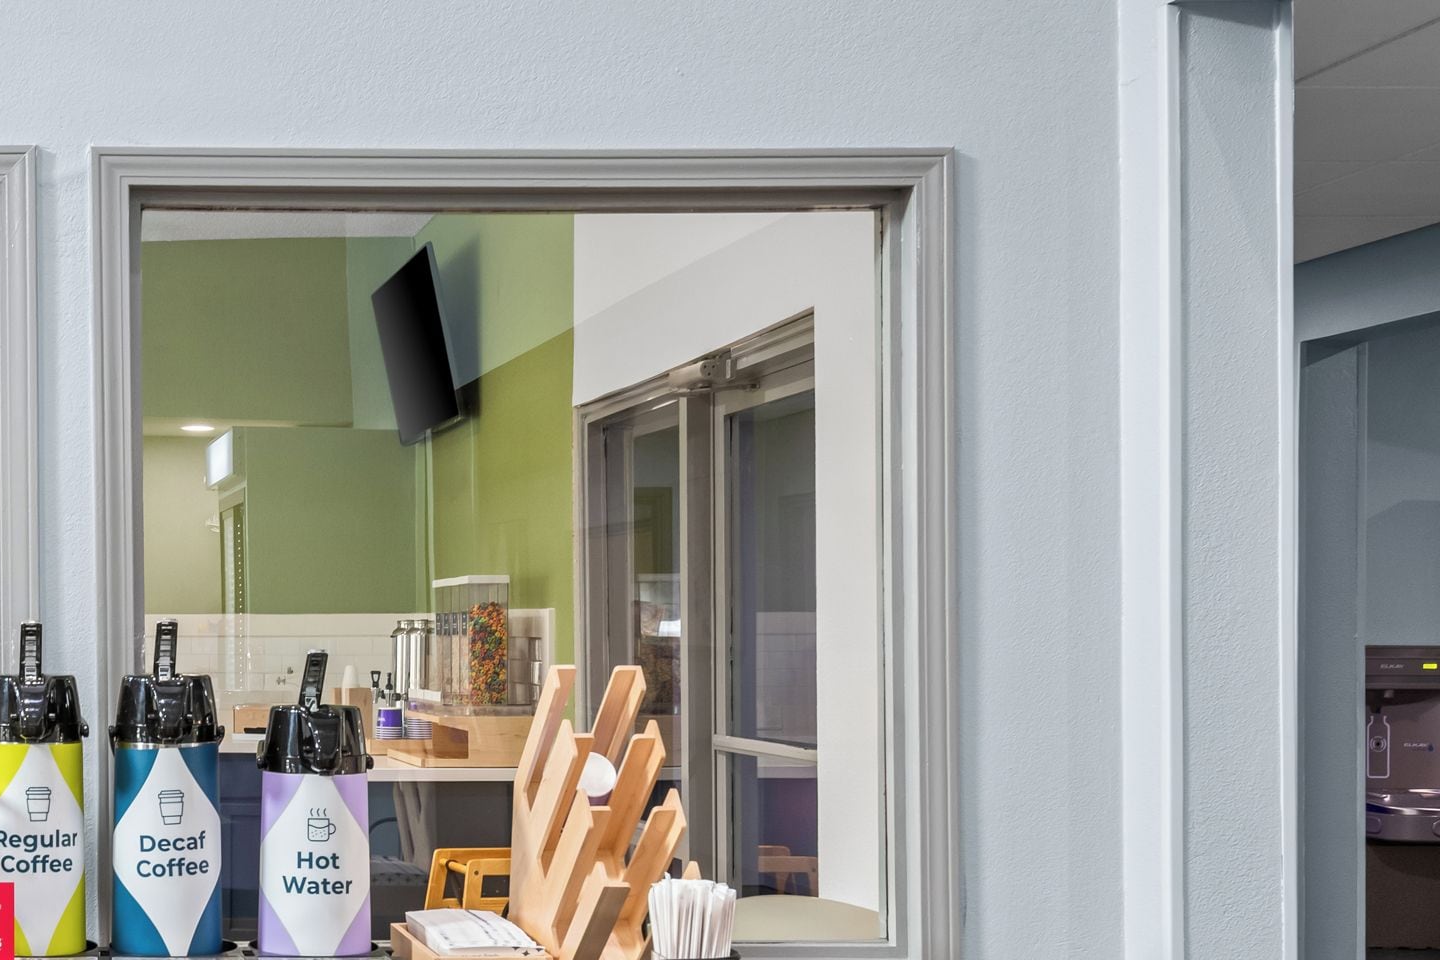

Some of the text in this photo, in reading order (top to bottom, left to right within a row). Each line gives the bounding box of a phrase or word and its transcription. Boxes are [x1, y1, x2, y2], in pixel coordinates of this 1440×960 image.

[139, 830, 206, 852] Decaf
[0, 854, 73, 873] Coffee
[136, 857, 209, 877] Coffee
[297, 851, 340, 870] Hot
[282, 875, 353, 895] Water
